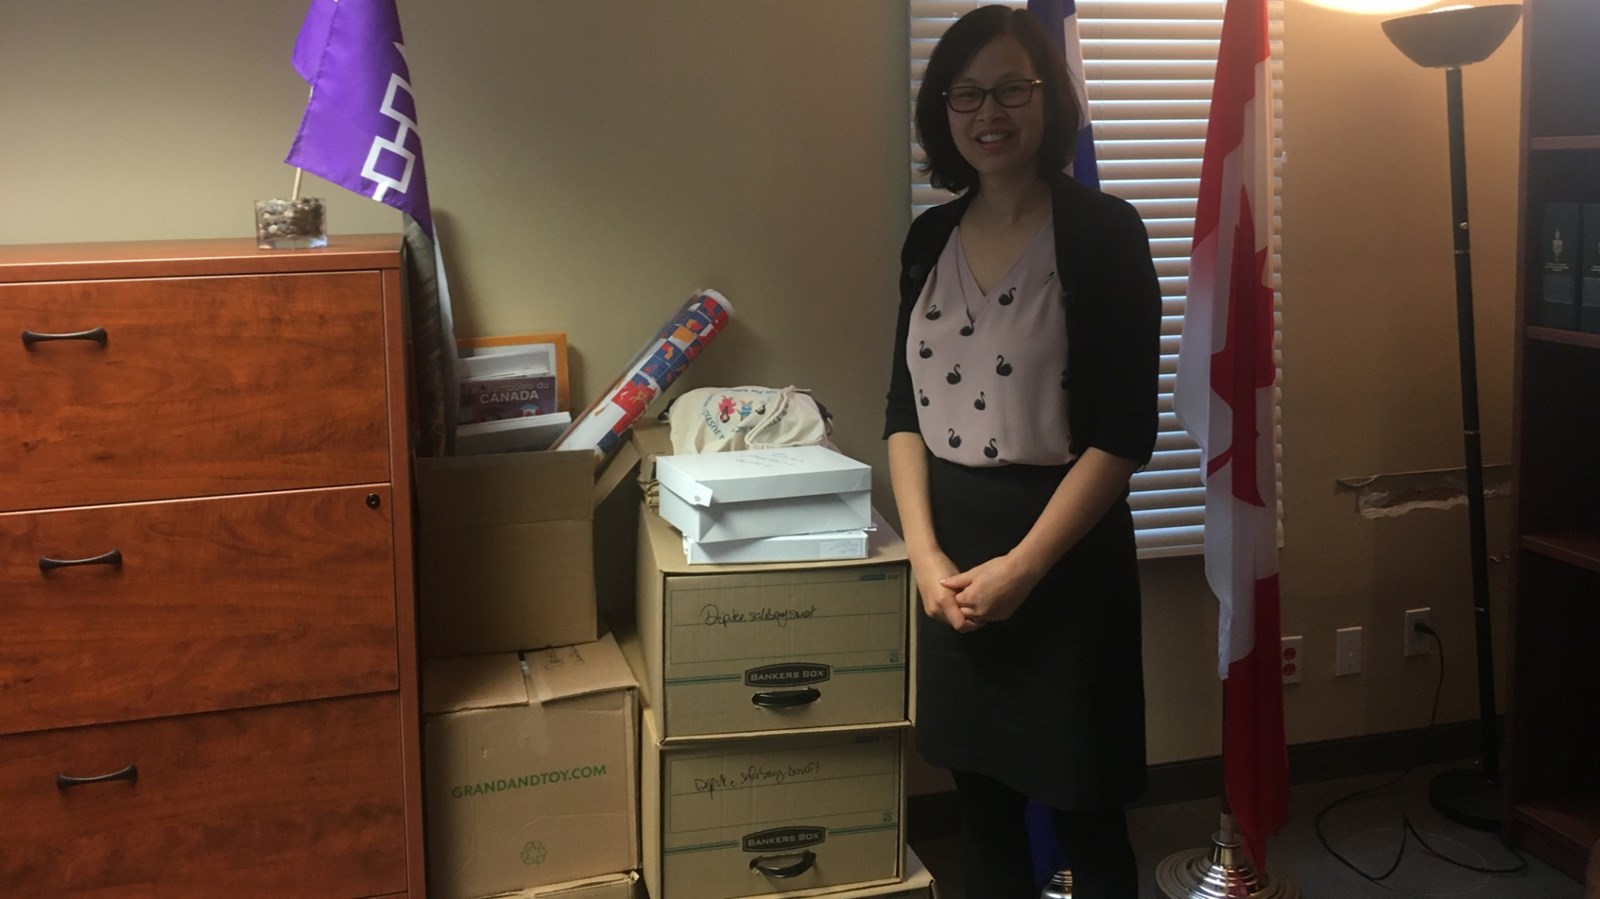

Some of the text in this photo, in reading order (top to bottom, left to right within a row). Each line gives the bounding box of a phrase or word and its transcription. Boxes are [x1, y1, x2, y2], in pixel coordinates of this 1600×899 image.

[480, 389, 540, 404] CANADA
[750, 670, 824, 681] BANKERS BOX
[451, 764, 607, 799] GRANDANDTOY.COM
[747, 832, 820, 847] BANKERS BOX
